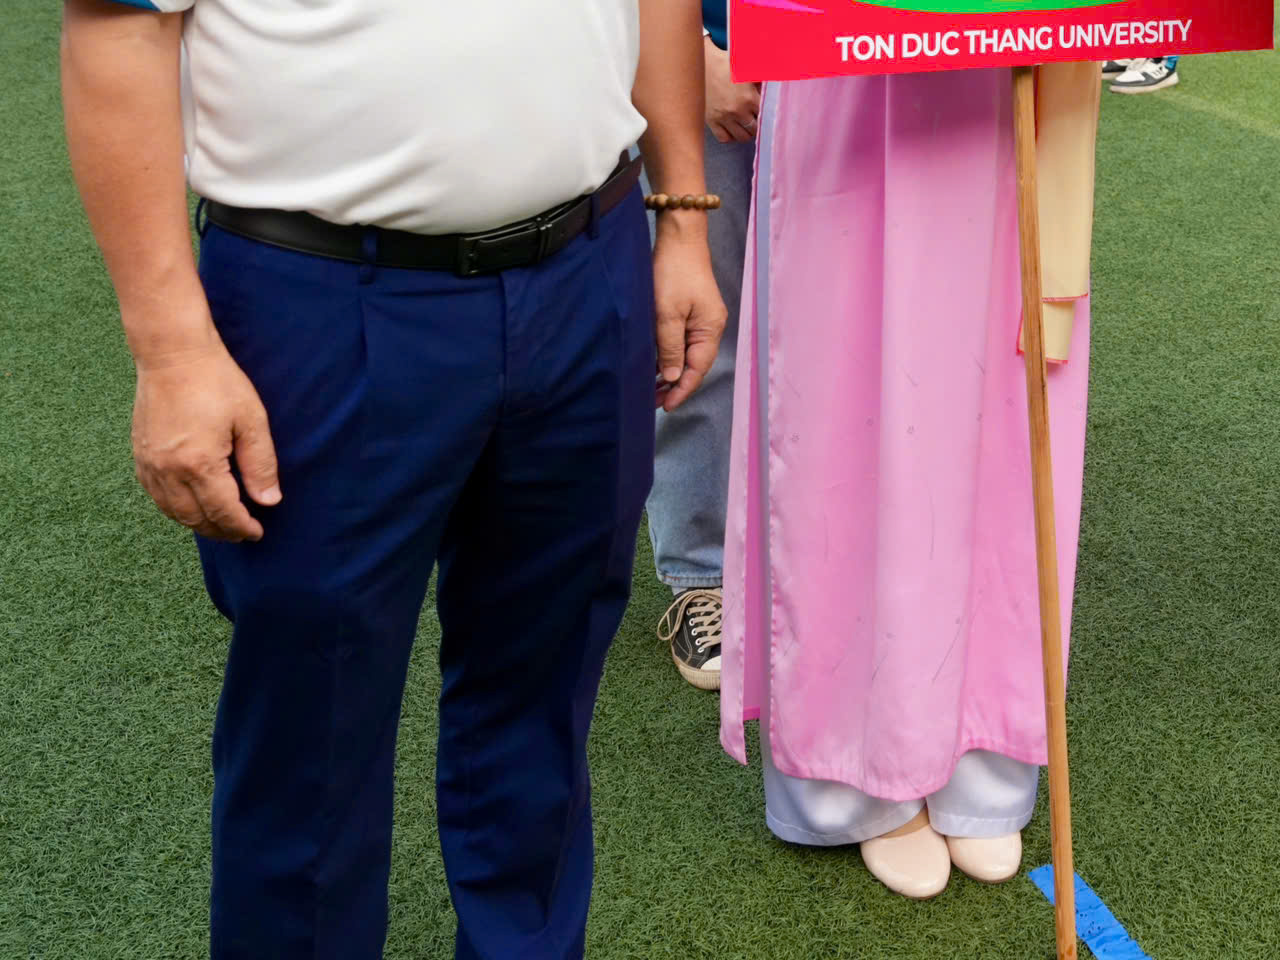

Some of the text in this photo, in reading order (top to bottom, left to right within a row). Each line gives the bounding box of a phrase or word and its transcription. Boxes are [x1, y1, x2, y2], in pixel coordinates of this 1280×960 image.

[835, 18, 1193, 62] TON DUC THANG UNIVERSITY
